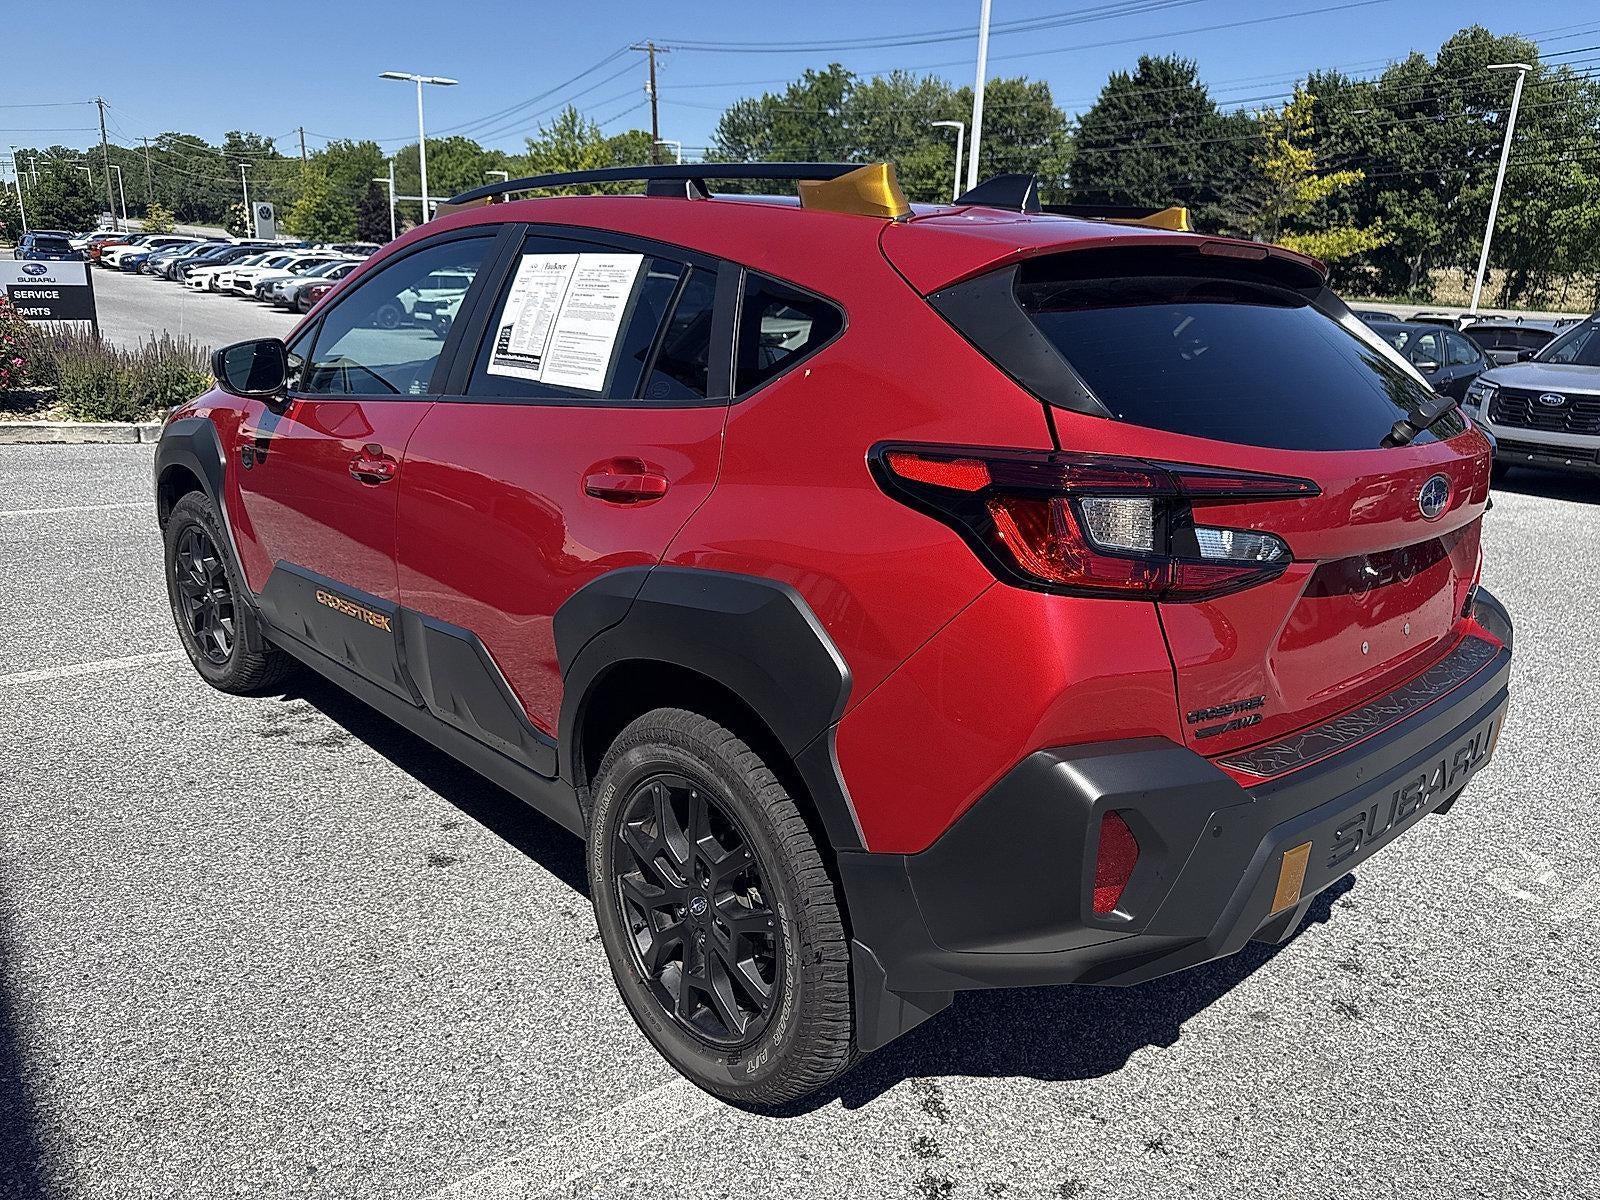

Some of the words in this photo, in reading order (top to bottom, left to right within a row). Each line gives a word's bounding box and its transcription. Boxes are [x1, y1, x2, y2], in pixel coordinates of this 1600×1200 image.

[14, 290, 60, 299] SERVICE
[17, 307, 51, 316] PARTS
[316, 589, 392, 633] CROSSTREK
[1186, 694, 1266, 724] CROSSTREK
[1326, 720, 1494, 870] SUBARU
[594, 783, 617, 882] YOKOHAMA
[773, 902, 794, 1046] GEOLANDAR
[746, 1048, 768, 1074] A/T
